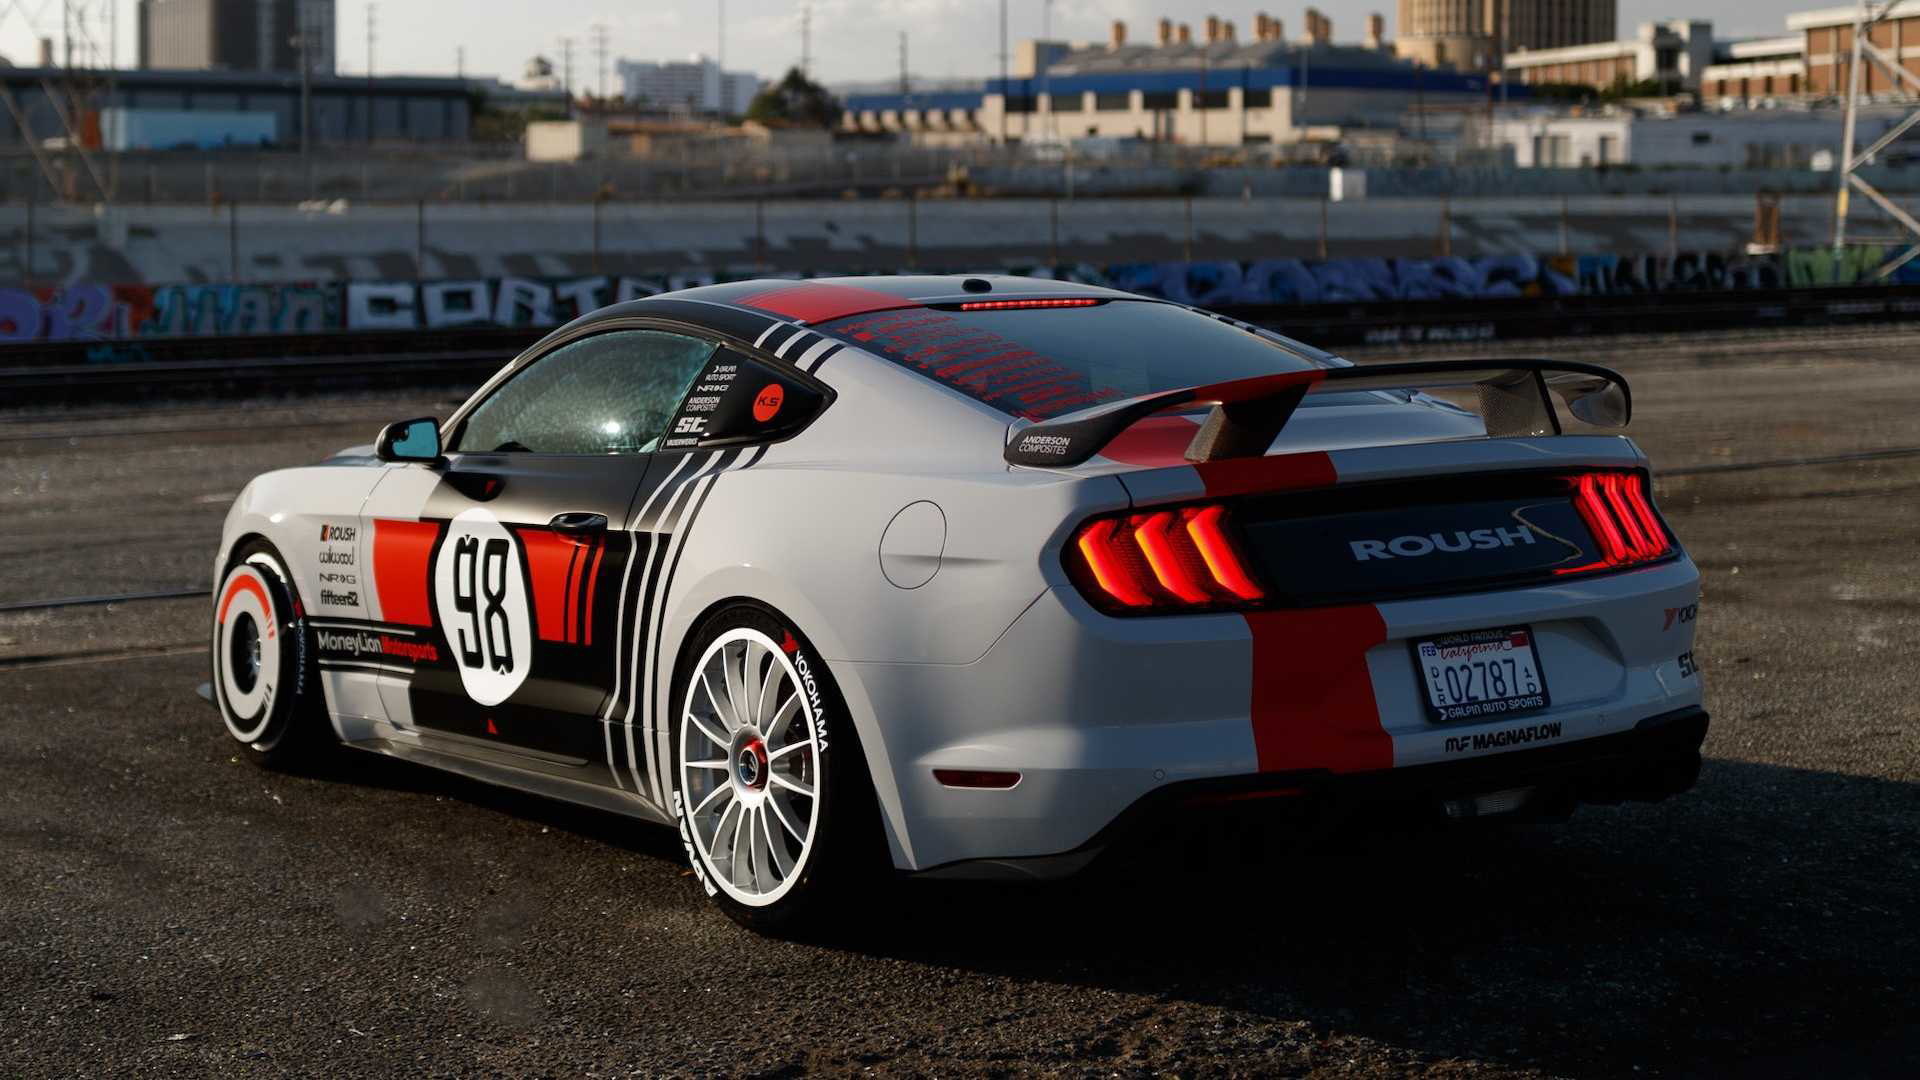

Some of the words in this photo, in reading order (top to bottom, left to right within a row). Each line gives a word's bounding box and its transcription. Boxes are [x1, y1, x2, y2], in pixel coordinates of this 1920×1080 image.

[687, 396, 721, 404] ANDERSON
[1018, 444, 1067, 455] COMPOSITES
[1021, 435, 1071, 446] ANDERSON
[328, 525, 356, 541] ROUSH
[1348, 524, 1537, 562] ROUSH
[320, 588, 360, 607] fifteen52
[453, 534, 514, 675] 98
[317, 630, 383, 656] MoneyLion
[382, 634, 438, 662] Motorsports
[1421, 645, 1437, 657] FEB
[1445, 658, 1518, 703] 02787
[794, 649, 829, 753] YOKOHAMA
[1447, 702, 1481, 720] GALPIN
[1483, 700, 1507, 714] AUTO
[1508, 695, 1544, 711] SPORTS
[1472, 722, 1562, 750] MAGNAFLOW
